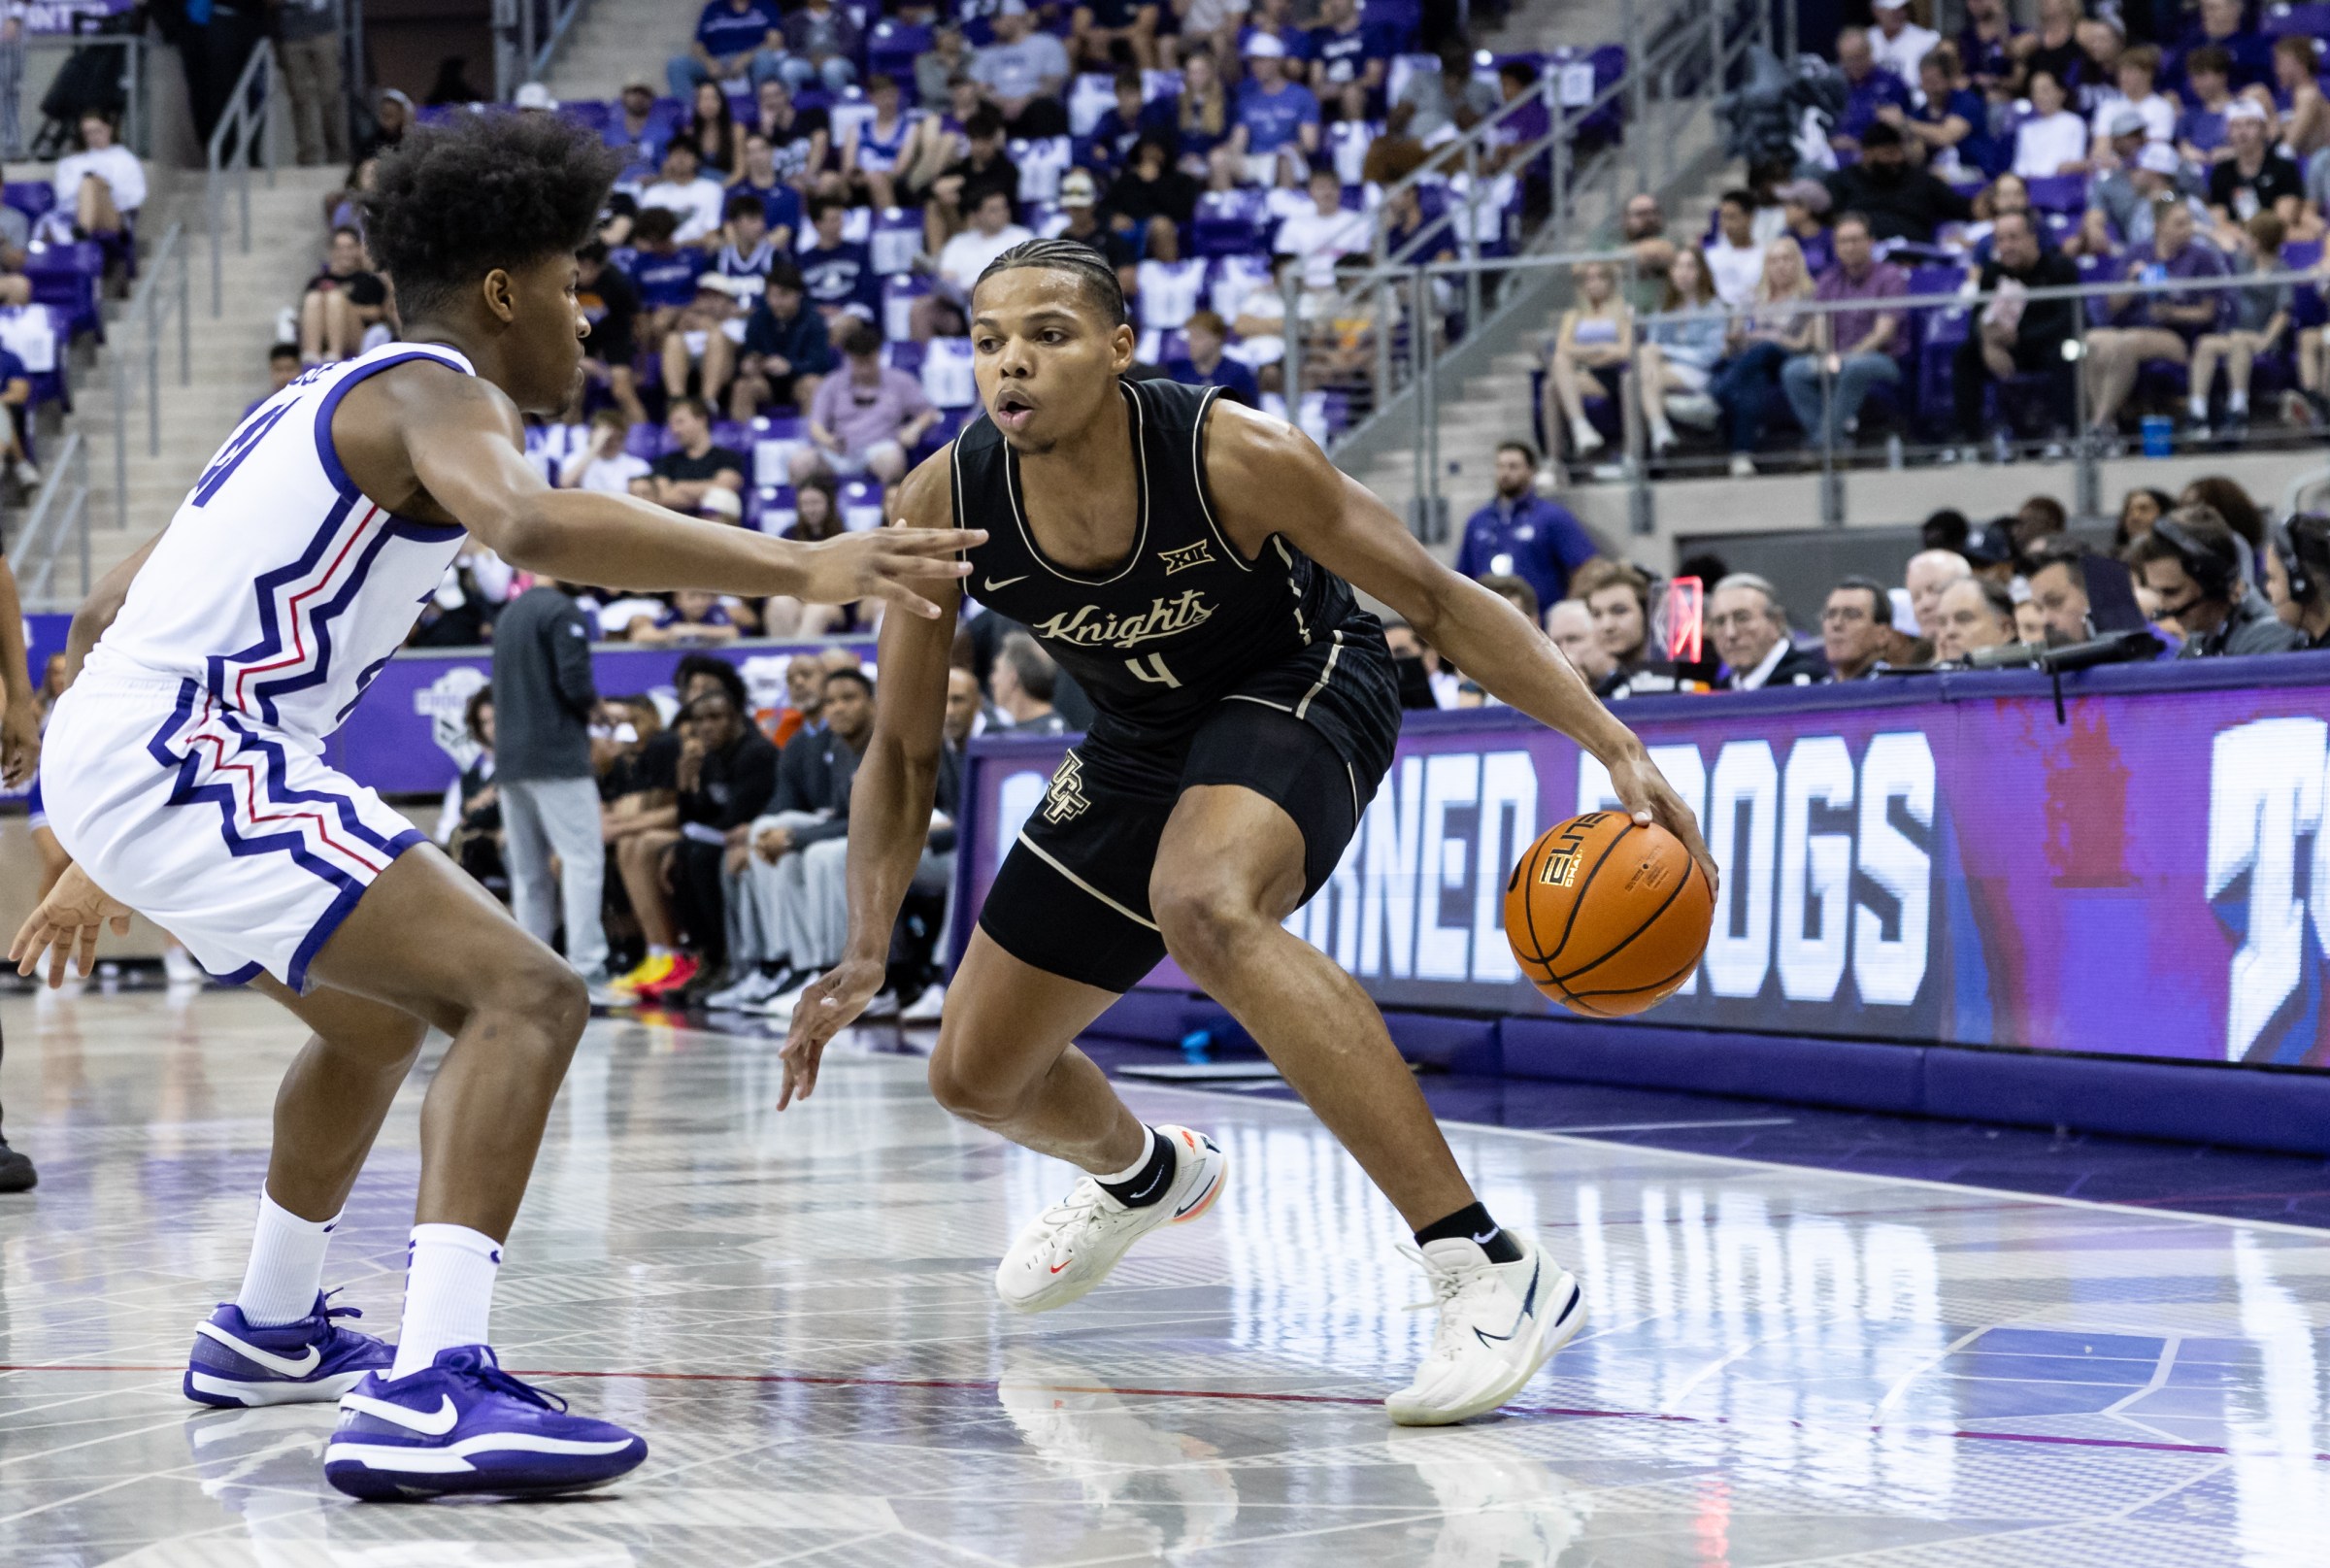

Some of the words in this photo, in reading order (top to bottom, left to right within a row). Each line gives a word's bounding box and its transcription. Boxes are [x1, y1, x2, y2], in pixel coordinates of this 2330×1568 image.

[1033, 589, 1219, 648] Knights
[1125, 652, 1182, 688] 4
[1044, 748, 1091, 824] UCF
[1538, 812, 1611, 886] ELITE
